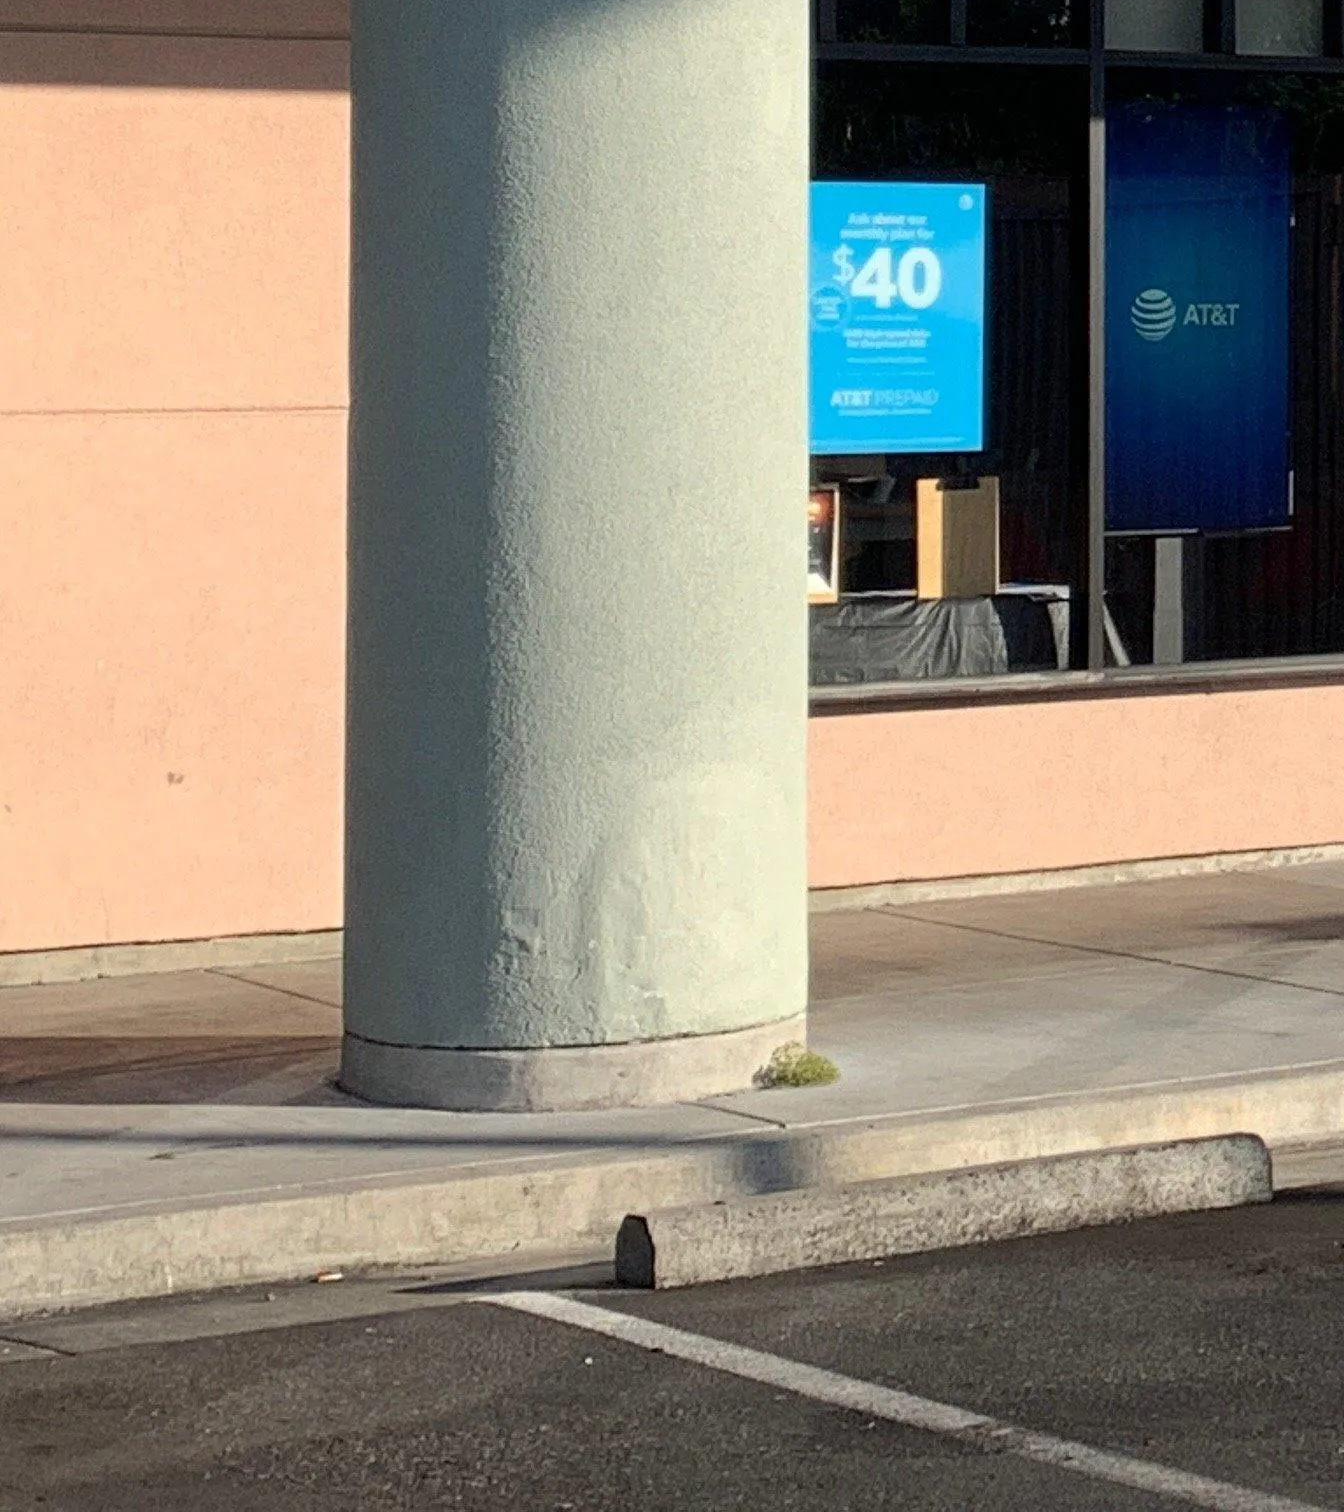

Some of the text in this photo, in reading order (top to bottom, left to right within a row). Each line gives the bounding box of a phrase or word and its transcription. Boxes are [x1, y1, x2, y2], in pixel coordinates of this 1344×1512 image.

[832, 244, 942, 309] $40
[1183, 303, 1240, 326] AT&T
[830, 390, 873, 407] AT&T
